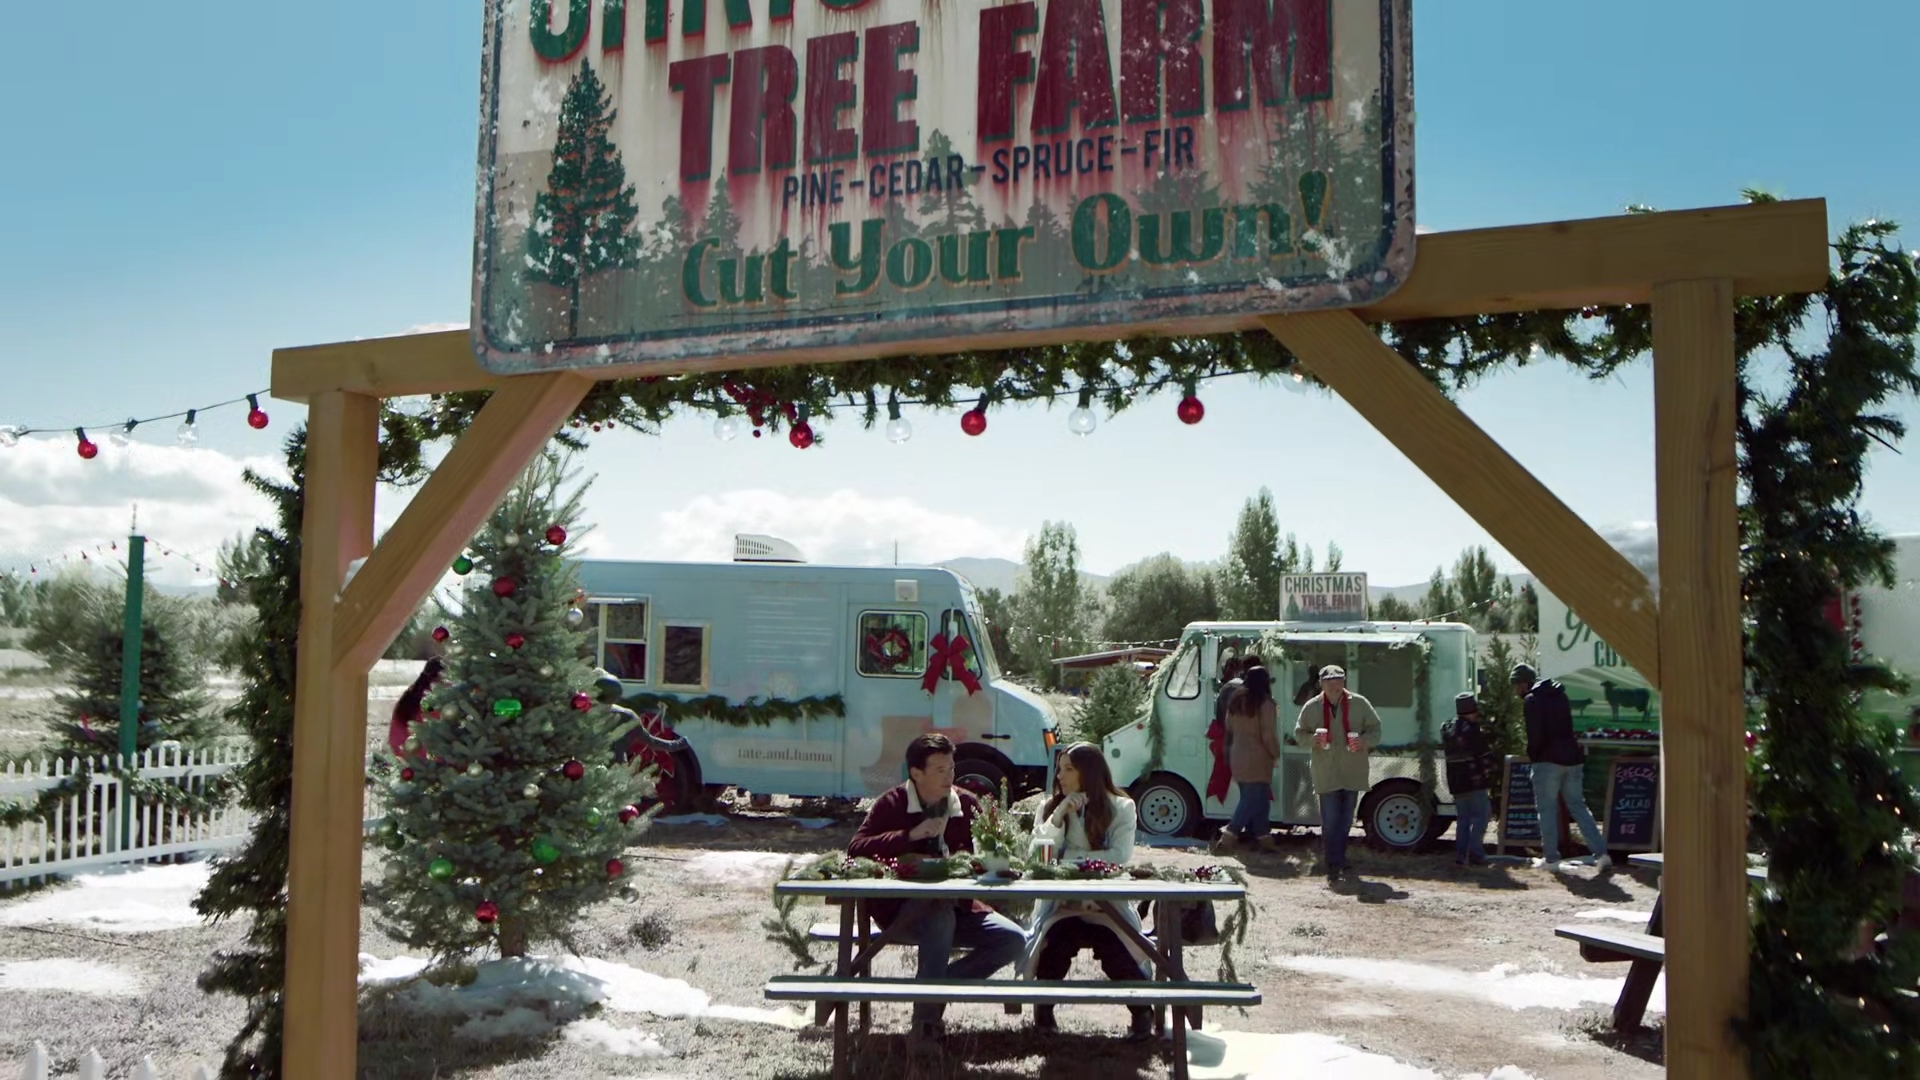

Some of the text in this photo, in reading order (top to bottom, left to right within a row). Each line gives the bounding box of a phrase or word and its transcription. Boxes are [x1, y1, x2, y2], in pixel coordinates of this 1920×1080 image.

[669, 20, 919, 183] TREE
[977, 0, 1334, 142] FARM
[682, 170, 1333, 309] Cut Your Own!
[1285, 576, 1362, 593] CHRISTMAS
[1302, 594, 1362, 608] TREE FARM
[1615, 798, 1651, 810] SALAD
